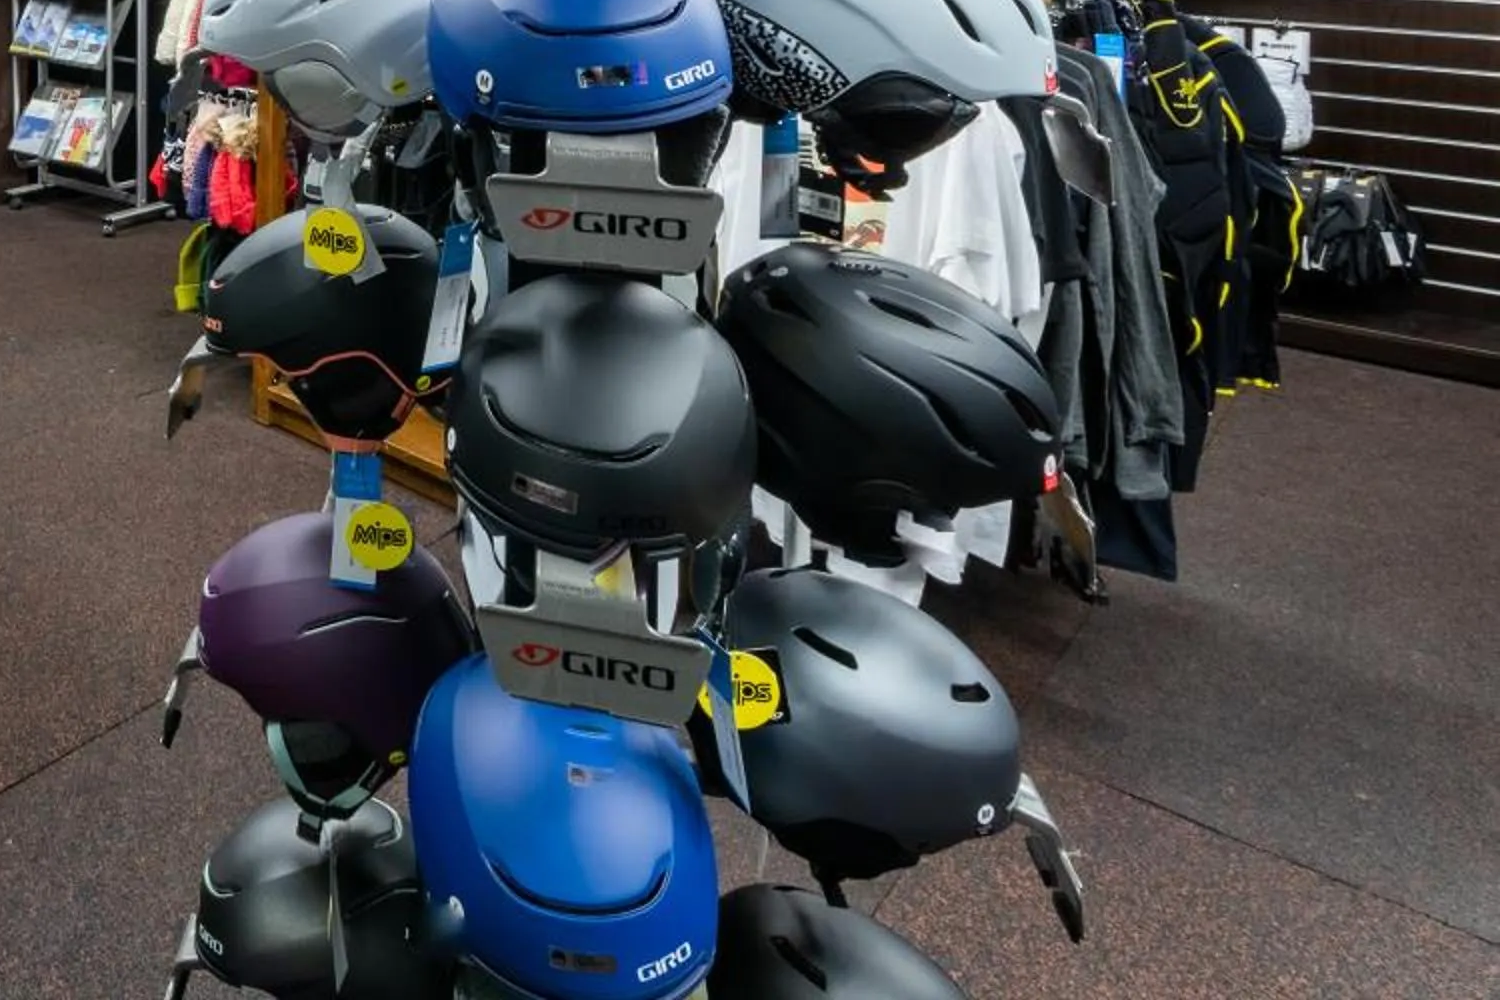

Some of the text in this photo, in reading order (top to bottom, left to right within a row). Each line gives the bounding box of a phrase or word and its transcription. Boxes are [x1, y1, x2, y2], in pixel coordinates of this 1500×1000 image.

[663, 59, 716, 91] GIRO
[573, 211, 688, 241] GIRO
[351, 520, 407, 550] Mips
[561, 650, 676, 692] GIRO
[735, 672, 772, 706] ips
[636, 941, 693, 983] GIRO
